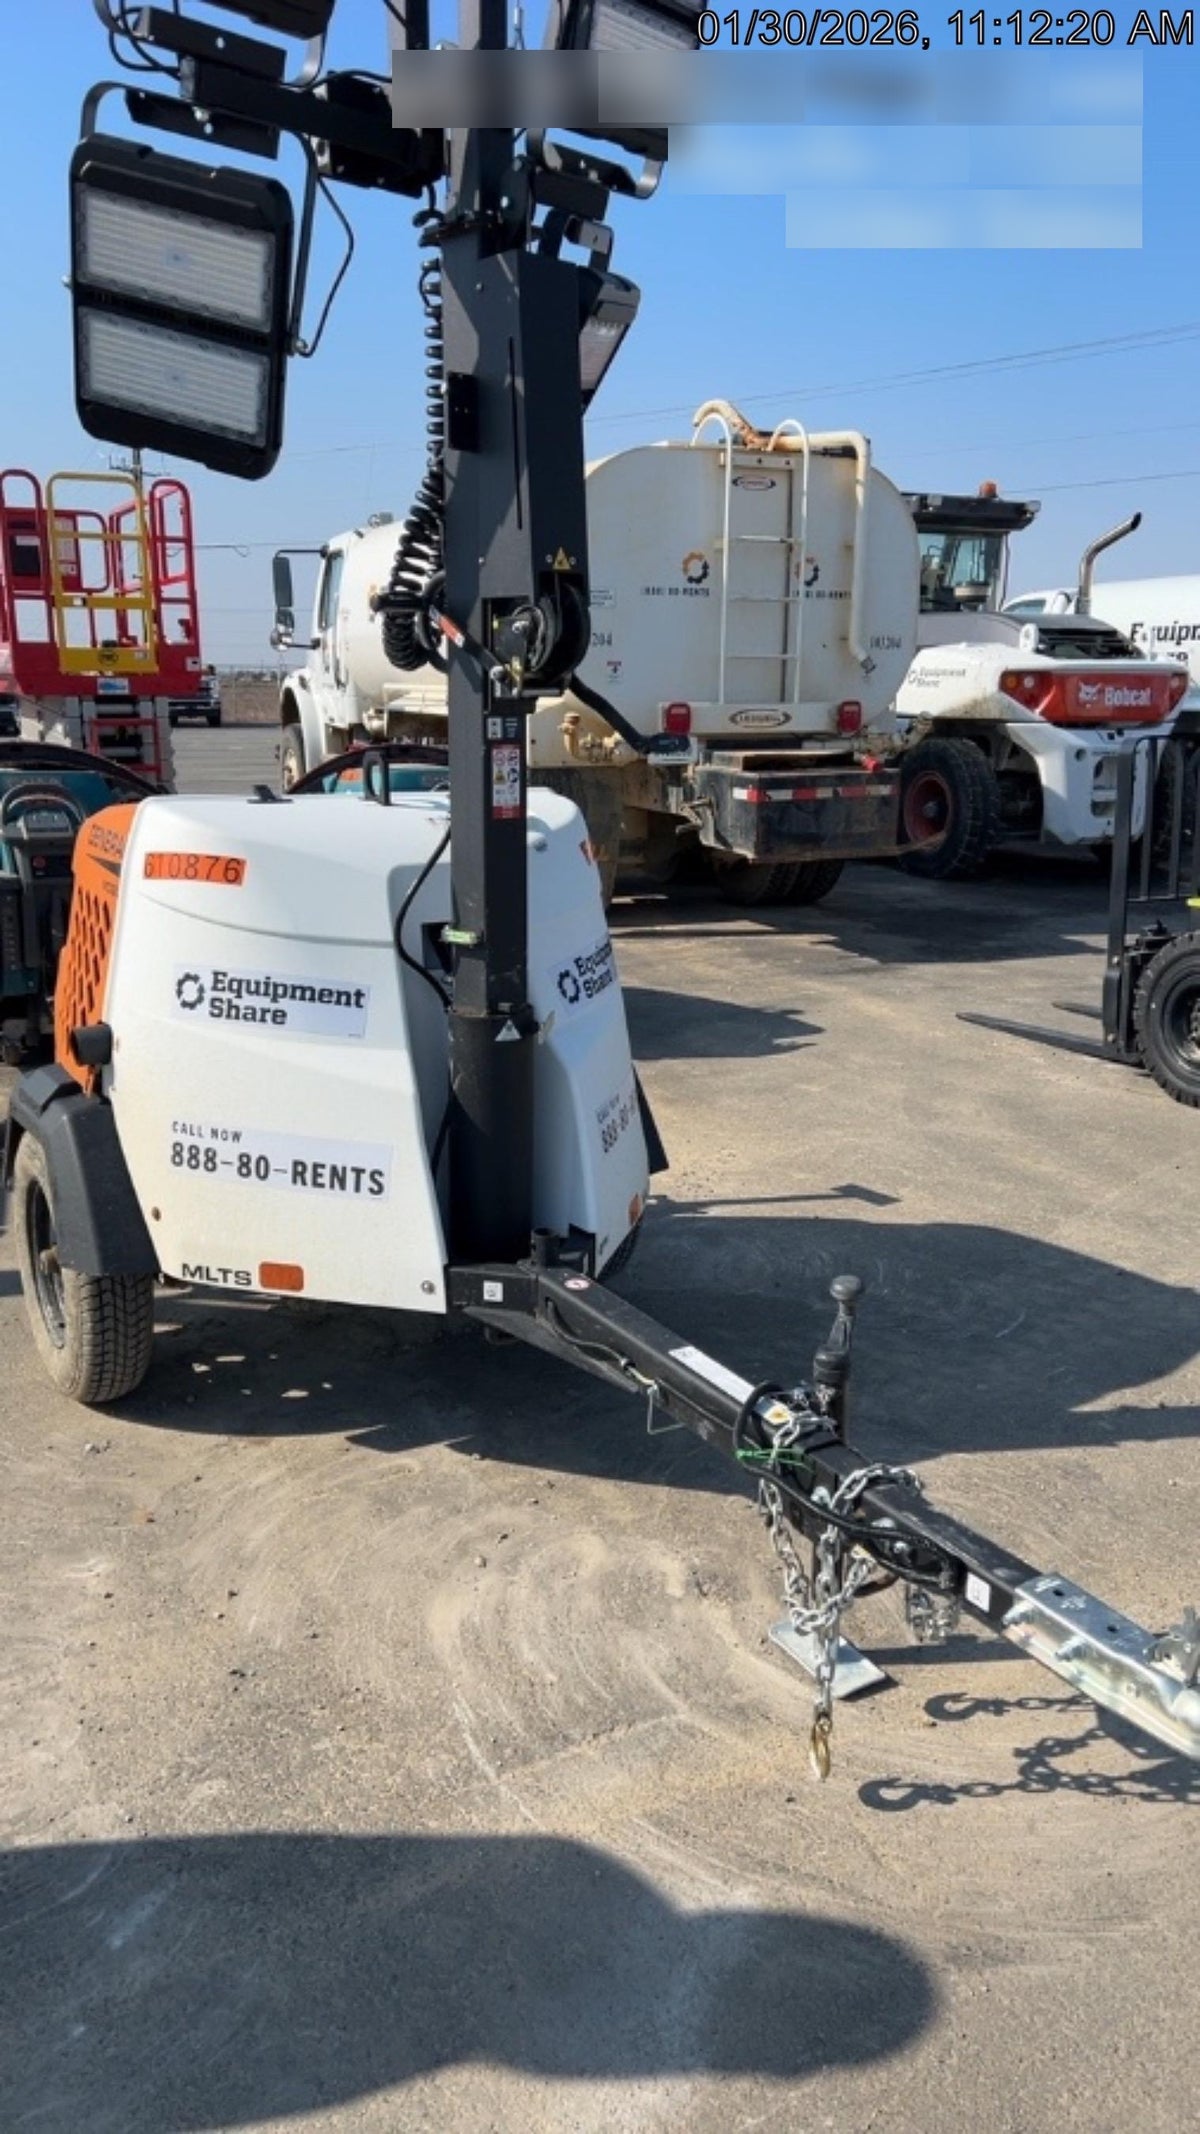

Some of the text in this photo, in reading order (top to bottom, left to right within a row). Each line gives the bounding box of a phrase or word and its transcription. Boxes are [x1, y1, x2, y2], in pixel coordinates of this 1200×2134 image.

[1131, 621, 1200, 645] Euip
[1104, 687, 1151, 706] Bobcat
[145, 853, 241, 883] 610876
[210, 971, 365, 1008] Equipment
[209, 998, 287, 1025] Share
[172, 1121, 242, 1143] CALL NOW
[170, 1142, 385, 1196] 888-80-RENTS
[181, 1263, 252, 1286] MLTS
